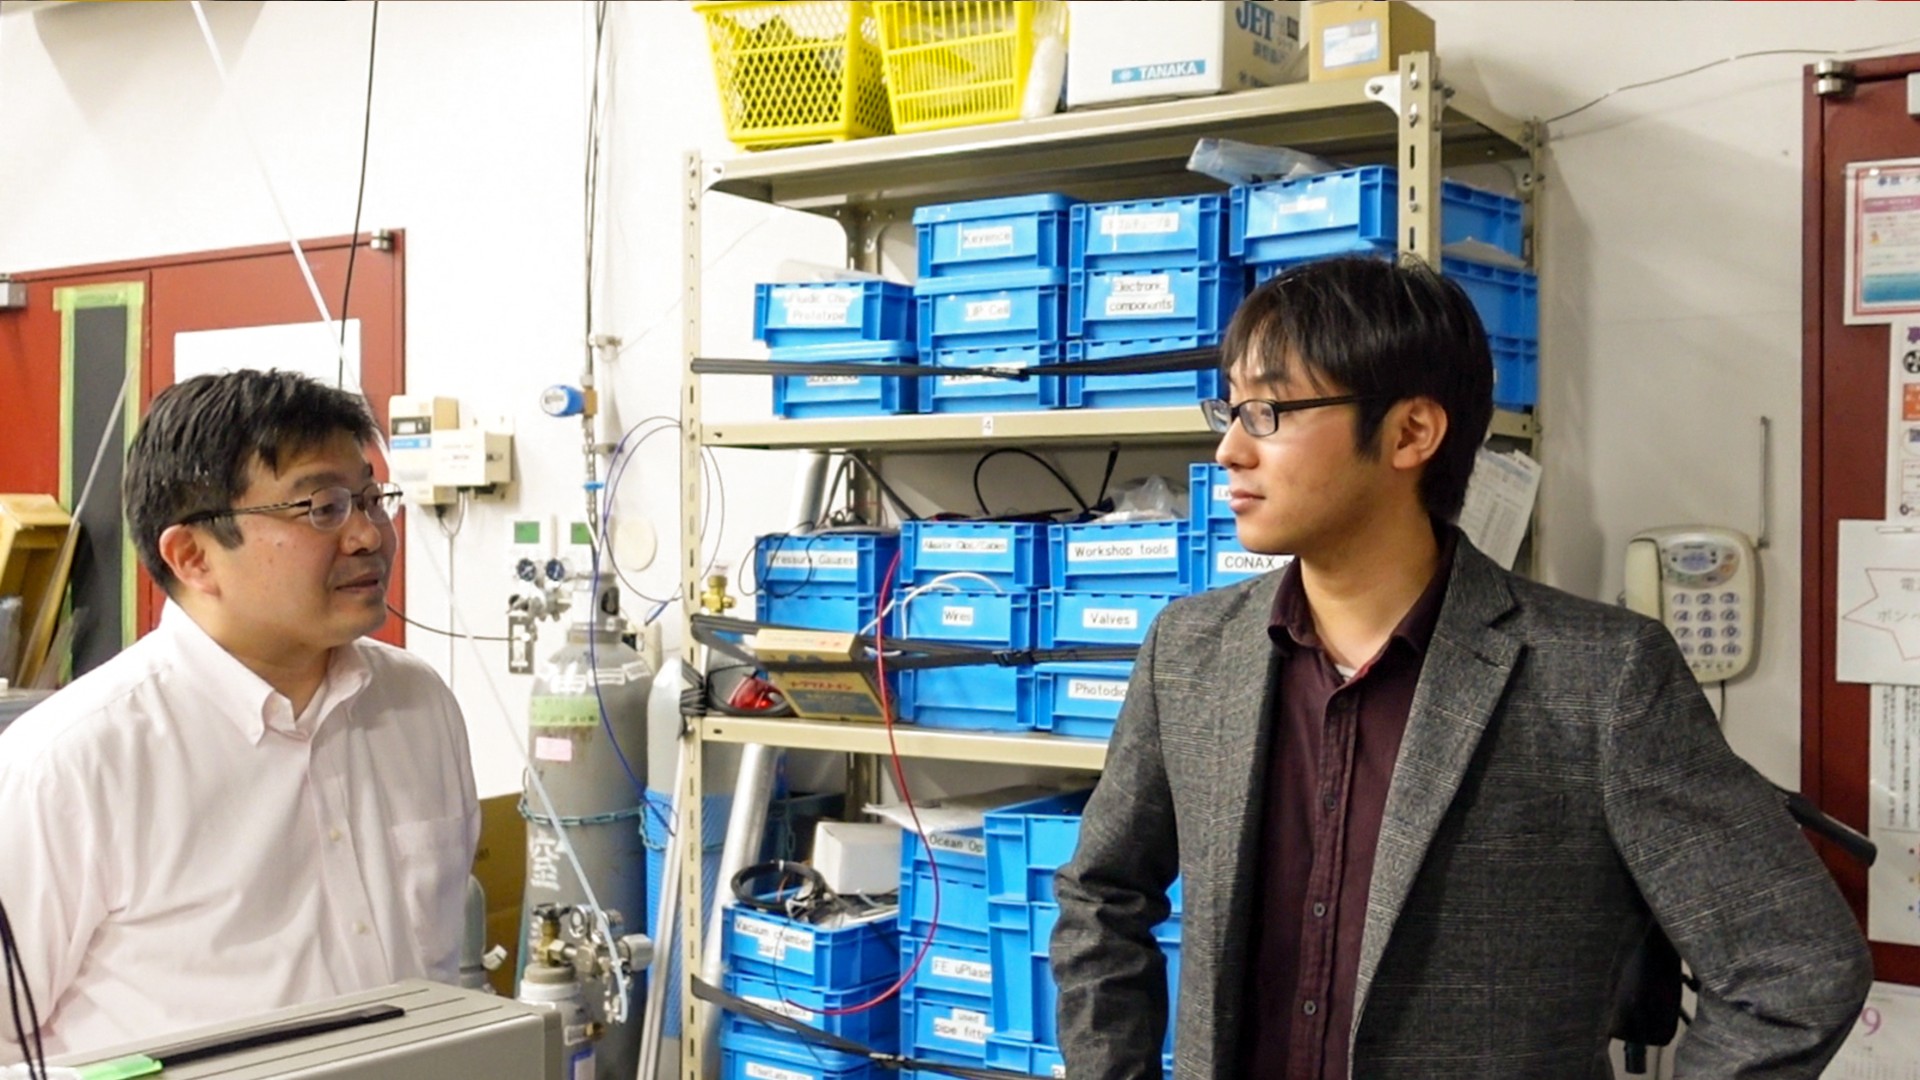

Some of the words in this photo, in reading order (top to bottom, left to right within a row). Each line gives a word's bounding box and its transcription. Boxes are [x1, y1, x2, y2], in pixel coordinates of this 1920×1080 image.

[1235, 1, 1274, 41] JET
[1140, 61, 1199, 80] TANAKA
[1108, 299, 1173, 313] components
[984, 420, 992, 430] 4
[1074, 545, 1134, 558] Workshop
[1140, 543, 1170, 555] tools
[1224, 556, 1275, 569] CONAX
[944, 610, 972, 622] Wires
[1091, 612, 1131, 625] Valves
[929, 833, 964, 849] Ocean
[735, 920, 769, 936] Vacuum
[957, 1013, 979, 1023] used
[1861, 1007, 1881, 1036] 9
[935, 1024, 957, 1036] pipe
